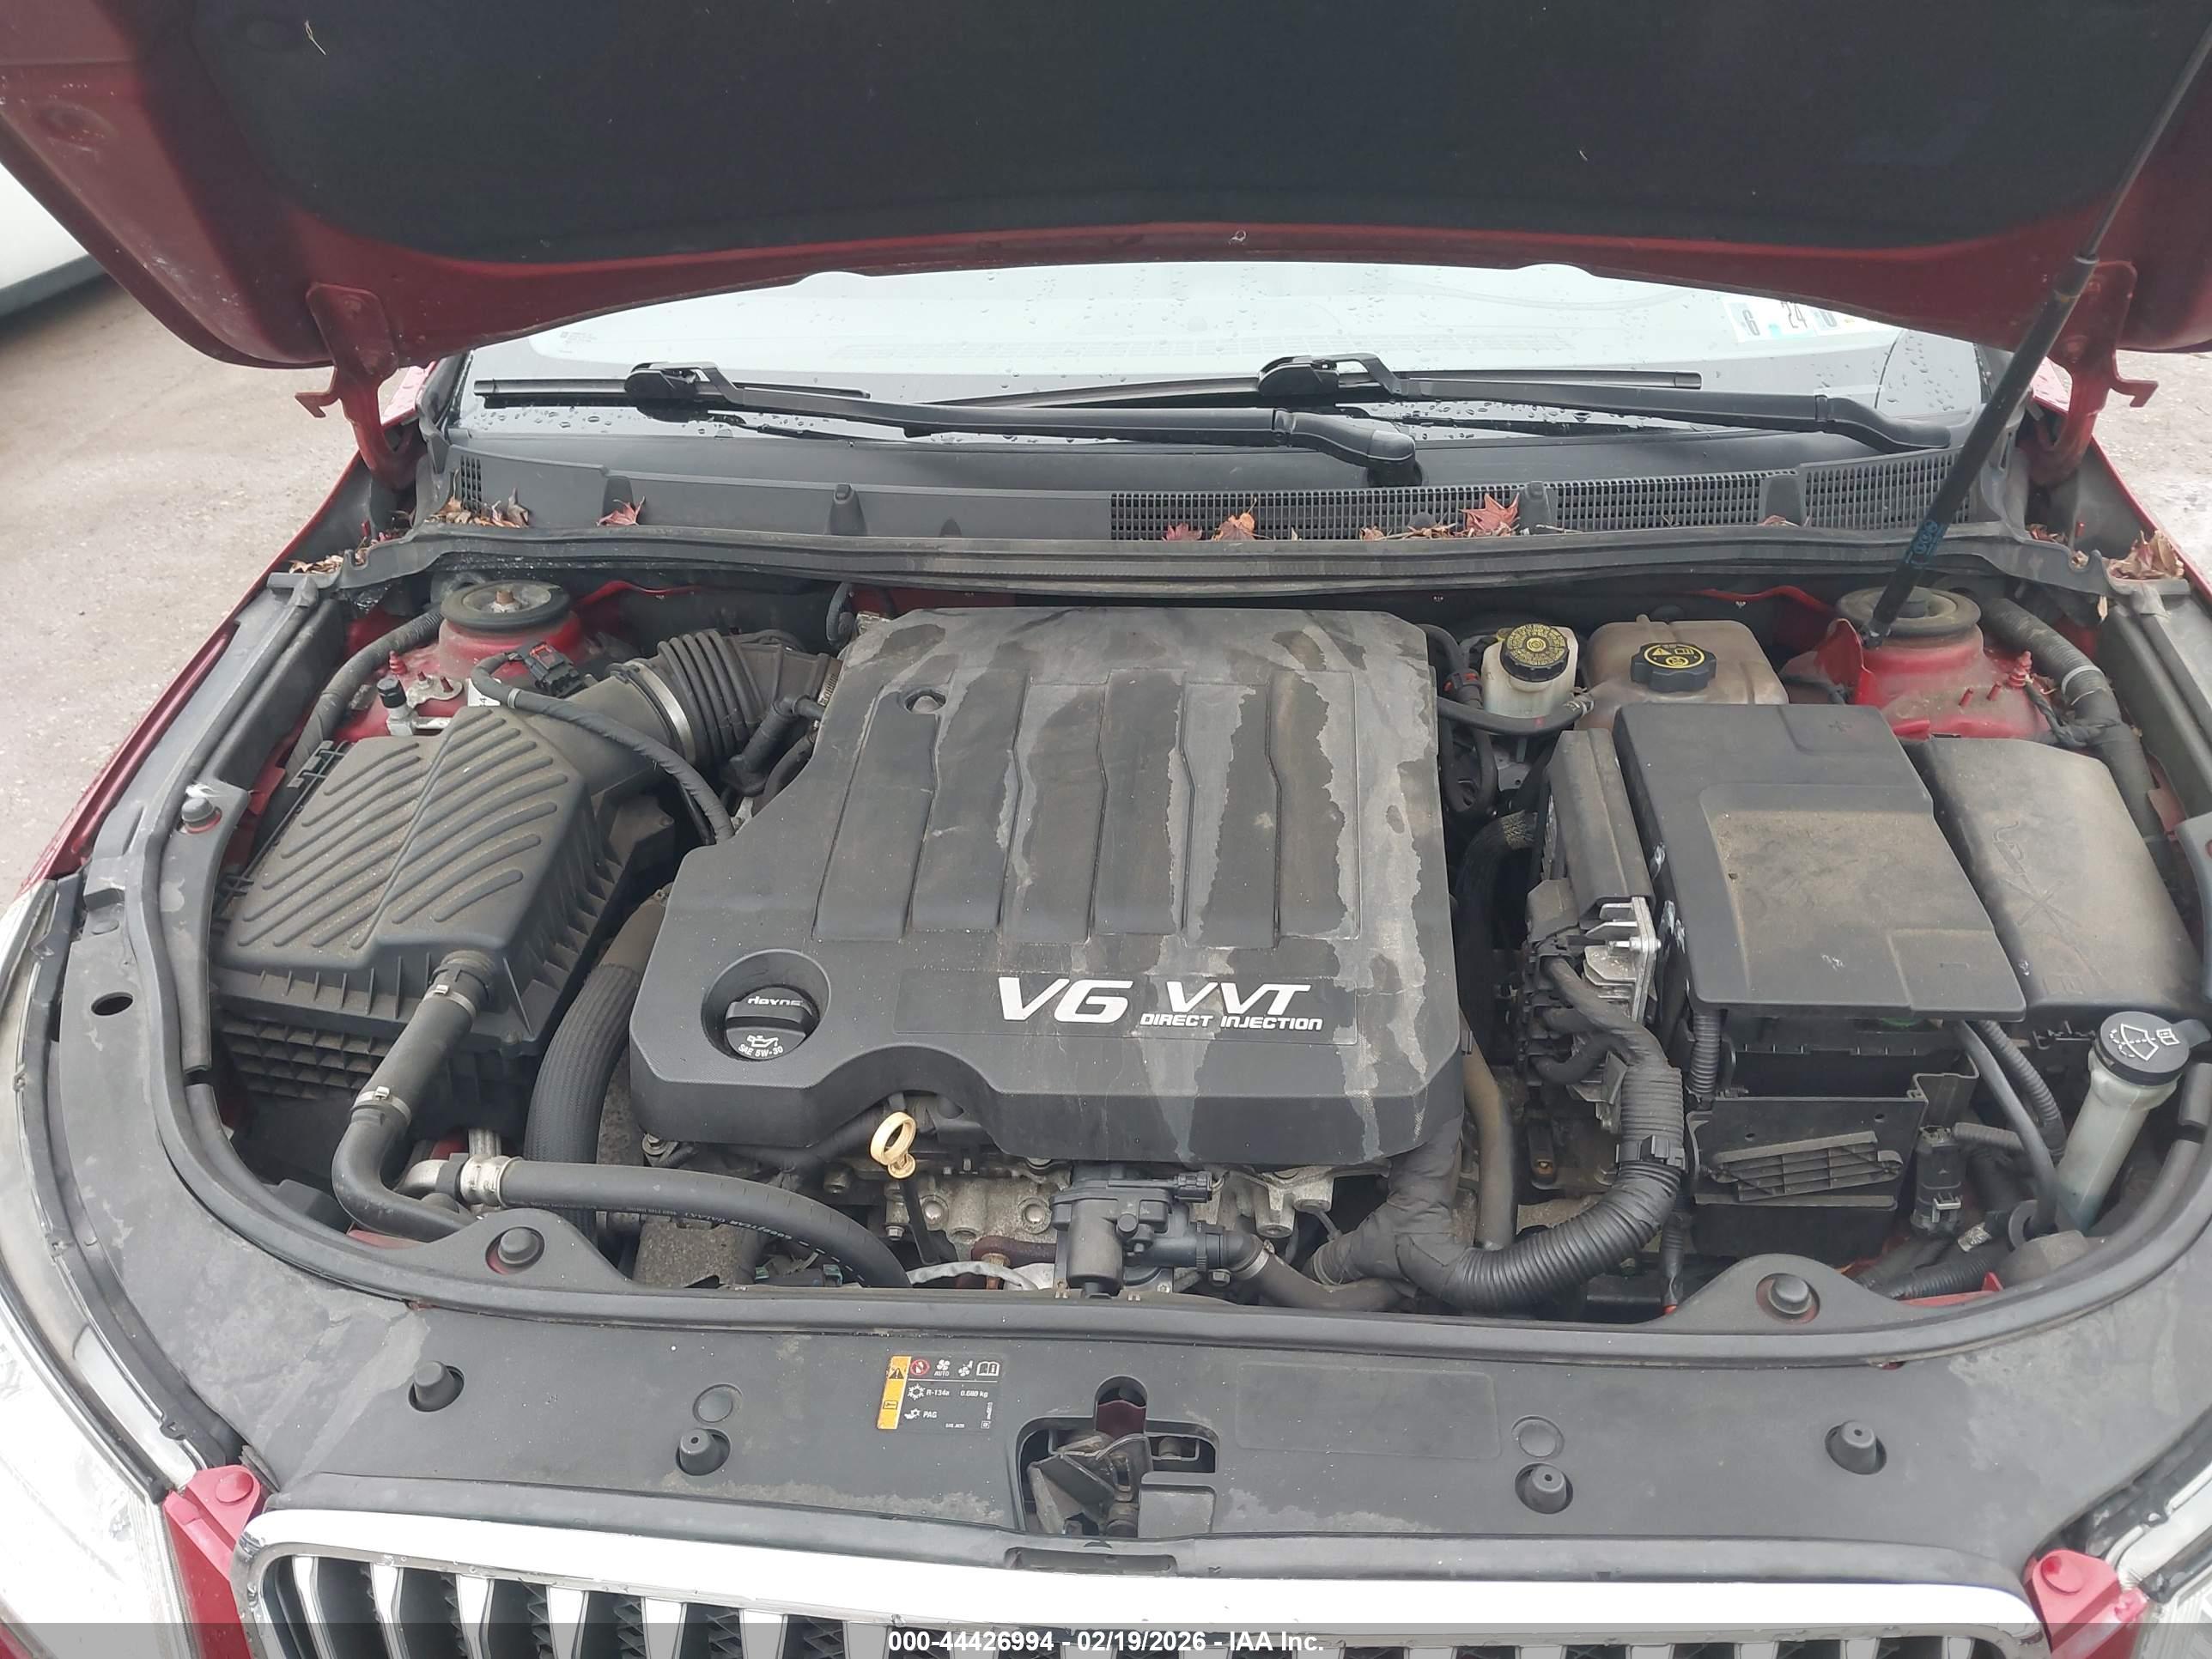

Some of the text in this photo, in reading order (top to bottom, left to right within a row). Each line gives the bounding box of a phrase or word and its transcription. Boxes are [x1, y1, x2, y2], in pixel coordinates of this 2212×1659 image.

[999, 977, 1311, 1024] V6 VVT
[1139, 1012, 1323, 1031] DIRECT INJECTION
[738, 1044, 784, 1057] SAE 5W-30
[926, 1388, 951, 1397] R-134a
[979, 1391, 989, 1400] kg
